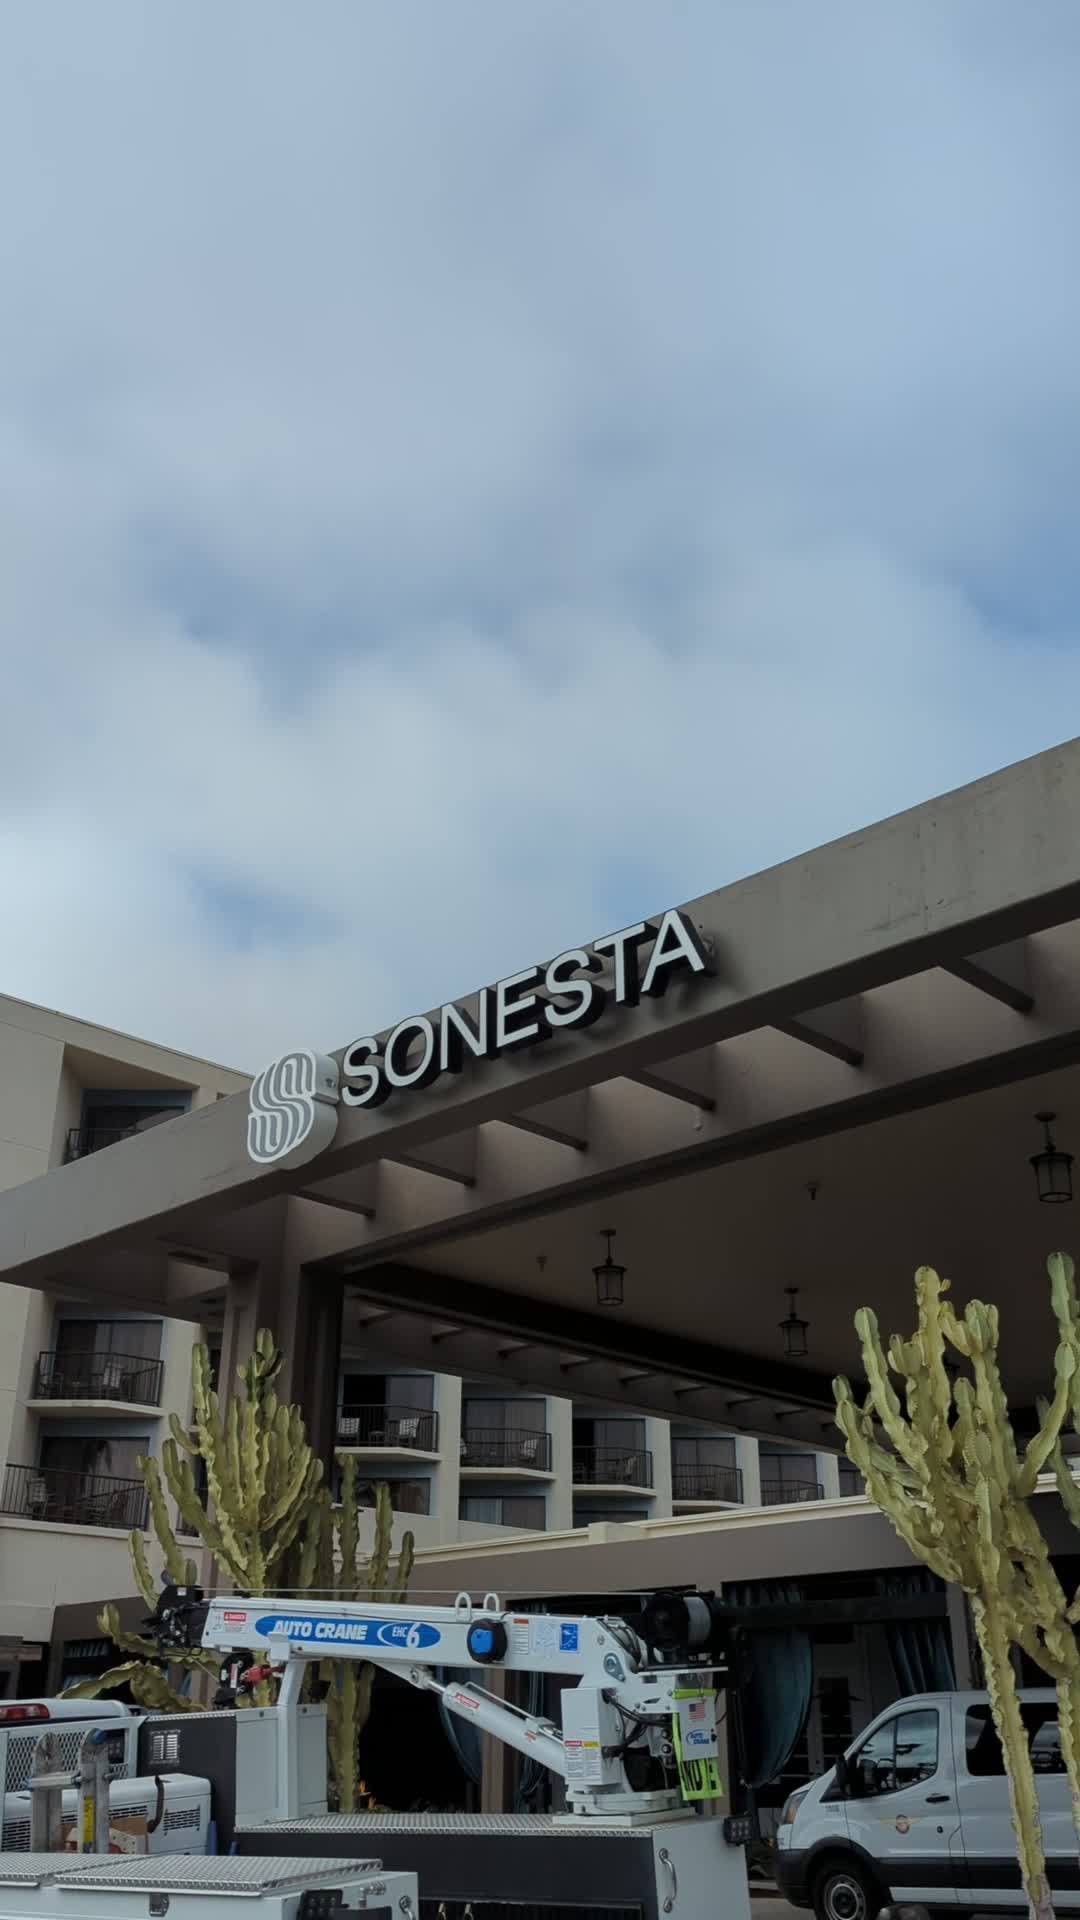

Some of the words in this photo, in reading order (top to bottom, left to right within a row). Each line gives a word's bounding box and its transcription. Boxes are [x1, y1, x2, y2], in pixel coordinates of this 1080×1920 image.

[341, 909, 705, 1107] SONESTA
[272, 1620, 311, 1638] AUTO
[315, 1622, 369, 1641] CRANE
[406, 1622, 421, 1649] 6
